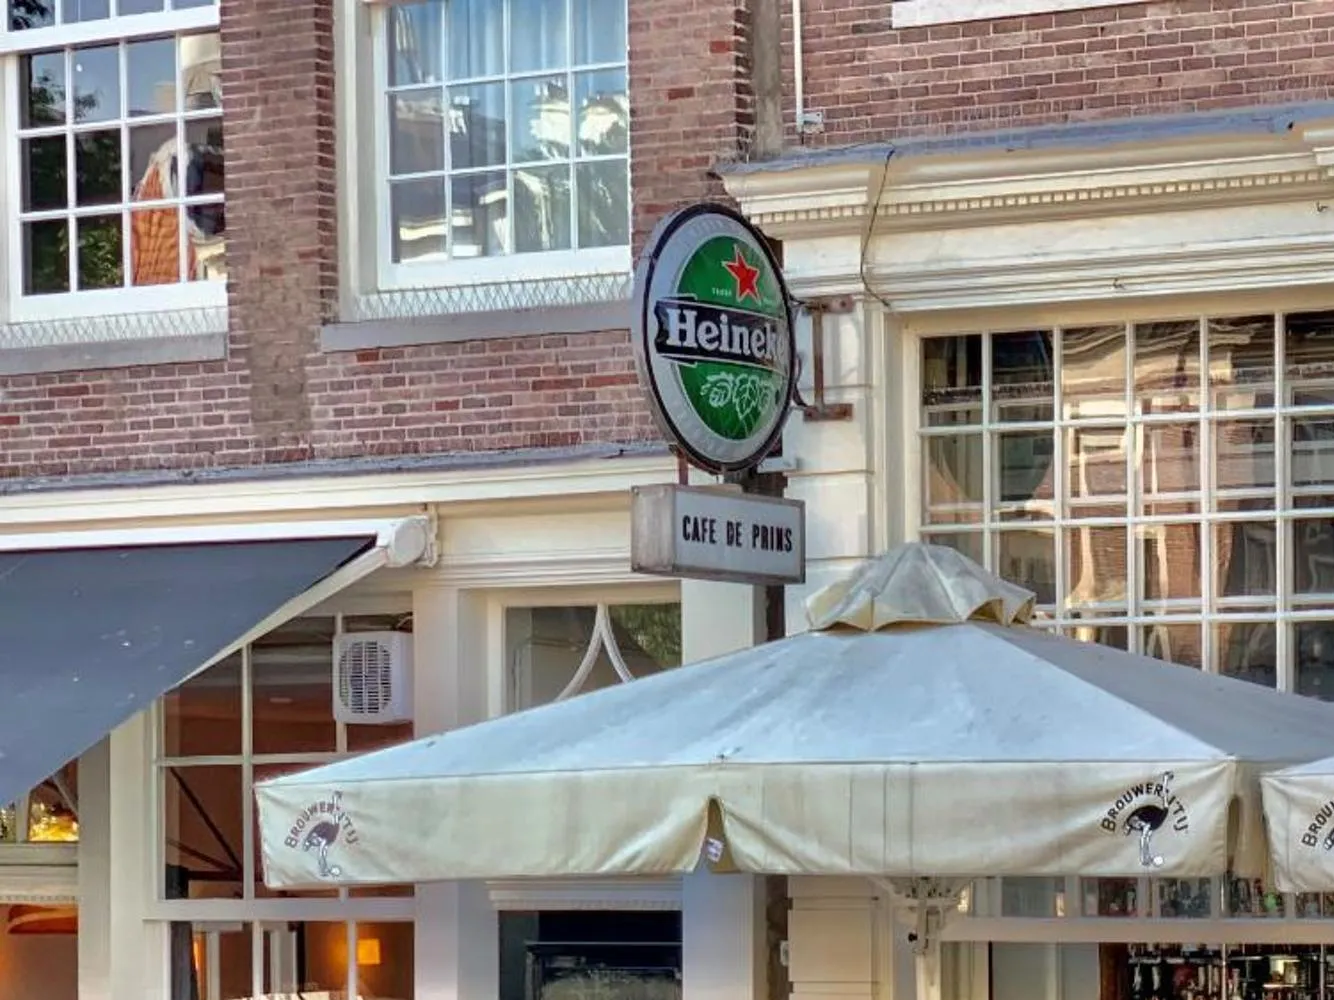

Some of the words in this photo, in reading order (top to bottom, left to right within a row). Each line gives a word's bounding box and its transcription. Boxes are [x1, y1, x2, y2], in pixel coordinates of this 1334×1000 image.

[682, 515, 717, 545] CAFE
[726, 520, 743, 548] DE
[752, 524, 792, 553] PRINS
